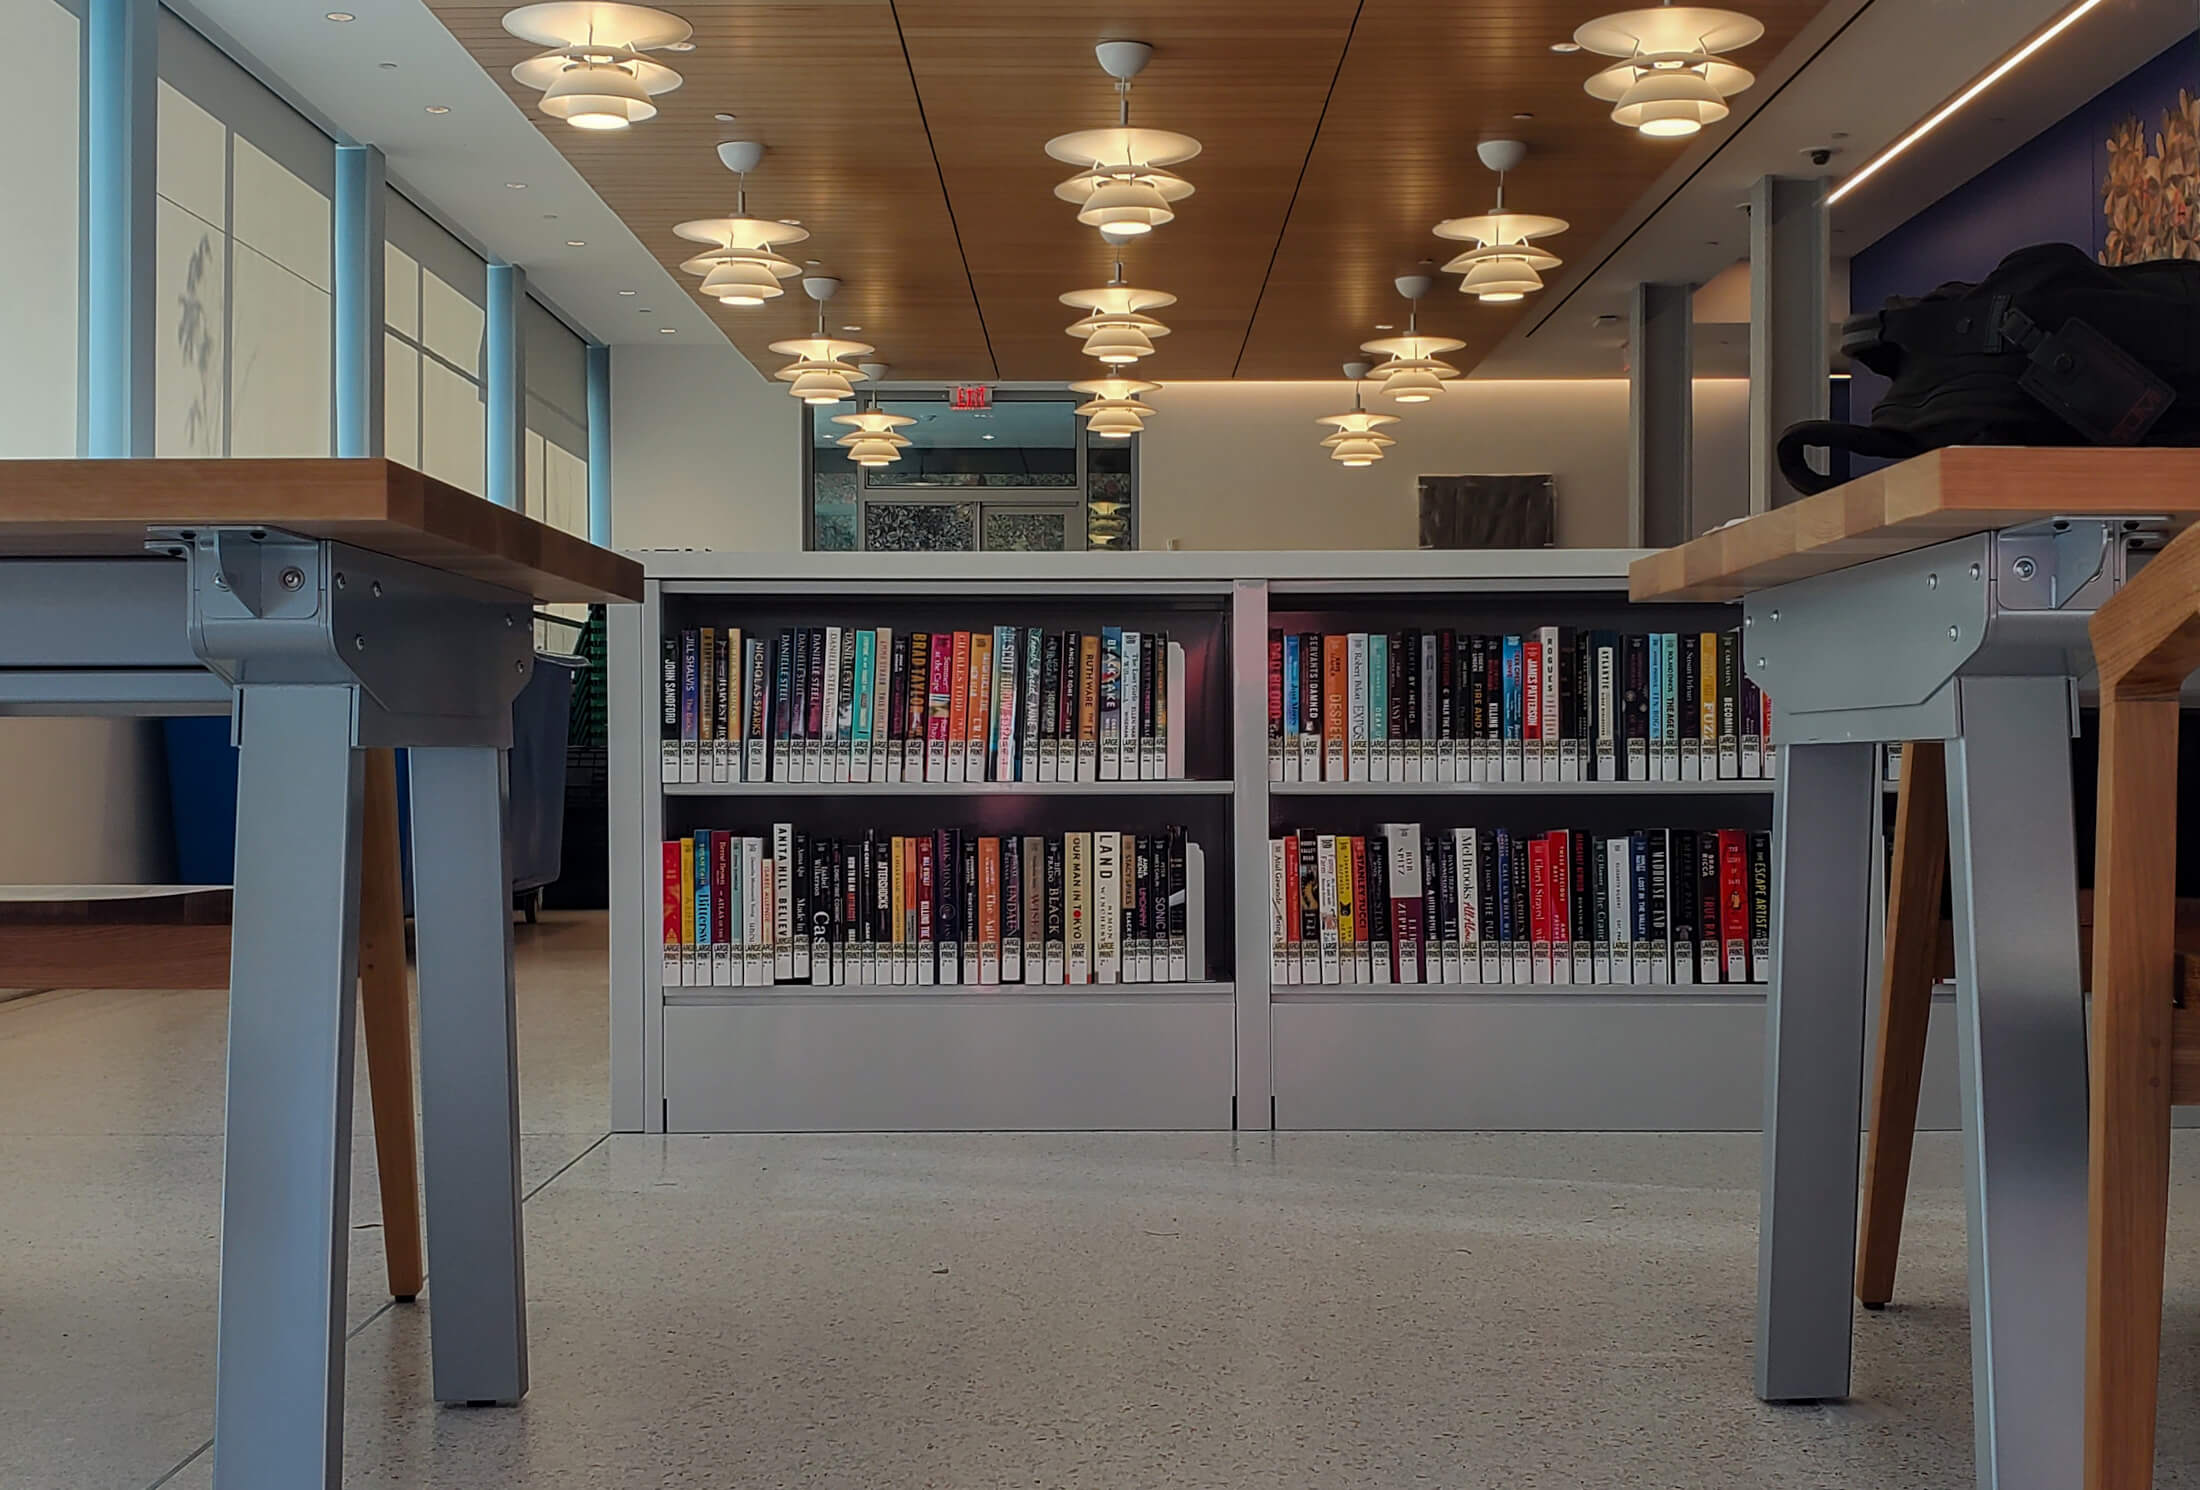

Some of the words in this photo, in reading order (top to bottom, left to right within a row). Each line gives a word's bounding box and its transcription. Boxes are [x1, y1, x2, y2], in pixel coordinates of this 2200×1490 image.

[957, 386, 985, 407] EXIT
[685, 636, 696, 653] JILL
[780, 634, 791, 675] DANIELLE
[797, 633, 807, 673] DANIELLE
[812, 634, 822, 675] DANIELLE
[829, 632, 839, 671] DANIELLE
[844, 632, 855, 676] DANIELLE
[912, 633, 928, 666] BRAD
[956, 634, 968, 682] CHARLES
[1001, 643, 1015, 674] SCOTT
[1106, 639, 1117, 676] BLACK
[1309, 635, 1319, 679] SERVANTS
[664, 659, 677, 681] JOHN
[685, 655, 695, 691] SHALVIS
[754, 642, 765, 697] NICHOLAS
[1085, 654, 1094, 679] RUTH
[1354, 652, 1363, 678] Robert
[1527, 658, 1538, 684] JAMES
[1601, 651, 1610, 690] ATLANTIC
[1686, 650, 1695, 674] Susan
[778, 678, 789, 703] STEEL
[795, 674, 805, 698] STEEL
[810, 677, 820, 702] STEEL
[827, 674, 836, 696] STEEL
[842, 677, 852, 702] STEEL
[909, 667, 926, 713] TAYLOR
[955, 684, 966, 711] TODD
[1000, 674, 1013, 711] TUROW
[1084, 680, 1093, 707] WARE
[1474, 683, 1483, 705] FIRE
[664, 682, 677, 725] SANDFORD
[1309, 682, 1319, 719] DAMNED
[1527, 684, 1538, 726] PATTERSON
[1666, 696, 1675, 712] THE
[752, 700, 763, 737] SPARKS
[1474, 706, 1483, 730] AND
[1666, 713, 1675, 729] AGE
[1723, 696, 1734, 739] BECOMIN
[778, 828, 788, 862] ANITA
[943, 832, 952, 861] DARK
[1072, 837, 1082, 861] OUR
[1099, 834, 1113, 880] LAND
[1462, 836, 1473, 856] Mel
[833, 865, 841, 882] LONG
[1072, 863, 1082, 886] MAN
[1125, 854, 1133, 877] STACY
[1356, 855, 1366, 896] STANLEY
[1397, 847, 1405, 876] SPITZ
[1405, 851, 1413, 872] BOB
[1533, 858, 1545, 887] Cheryl
[1652, 851, 1665, 899] MADHOUSE
[1701, 853, 1709, 878] RICCA
[778, 866, 788, 890] HILL
[813, 859, 823, 897] Wilkerson
[877, 861, 888, 910] AFTERSHOCKS
[1274, 872, 1284, 905] Gawande
[1462, 858, 1475, 900] Brooks
[1754, 862, 1767, 896] ESCAPE
[1072, 889, 1082, 901] IN
[1484, 896, 1494, 918] THE
[1531, 889, 1545, 920] Strayed
[1596, 891, 1606, 910] The
[797, 898, 807, 922] Made
[1048, 888, 1061, 934] BLACK
[1072, 904, 1083, 940] TOKYO
[1155, 896, 1166, 930] SONIC
[1358, 899, 1367, 928] TUCCI
[1637, 912, 1646, 934] VALLEY
[1755, 898, 1768, 929] ARTIST
